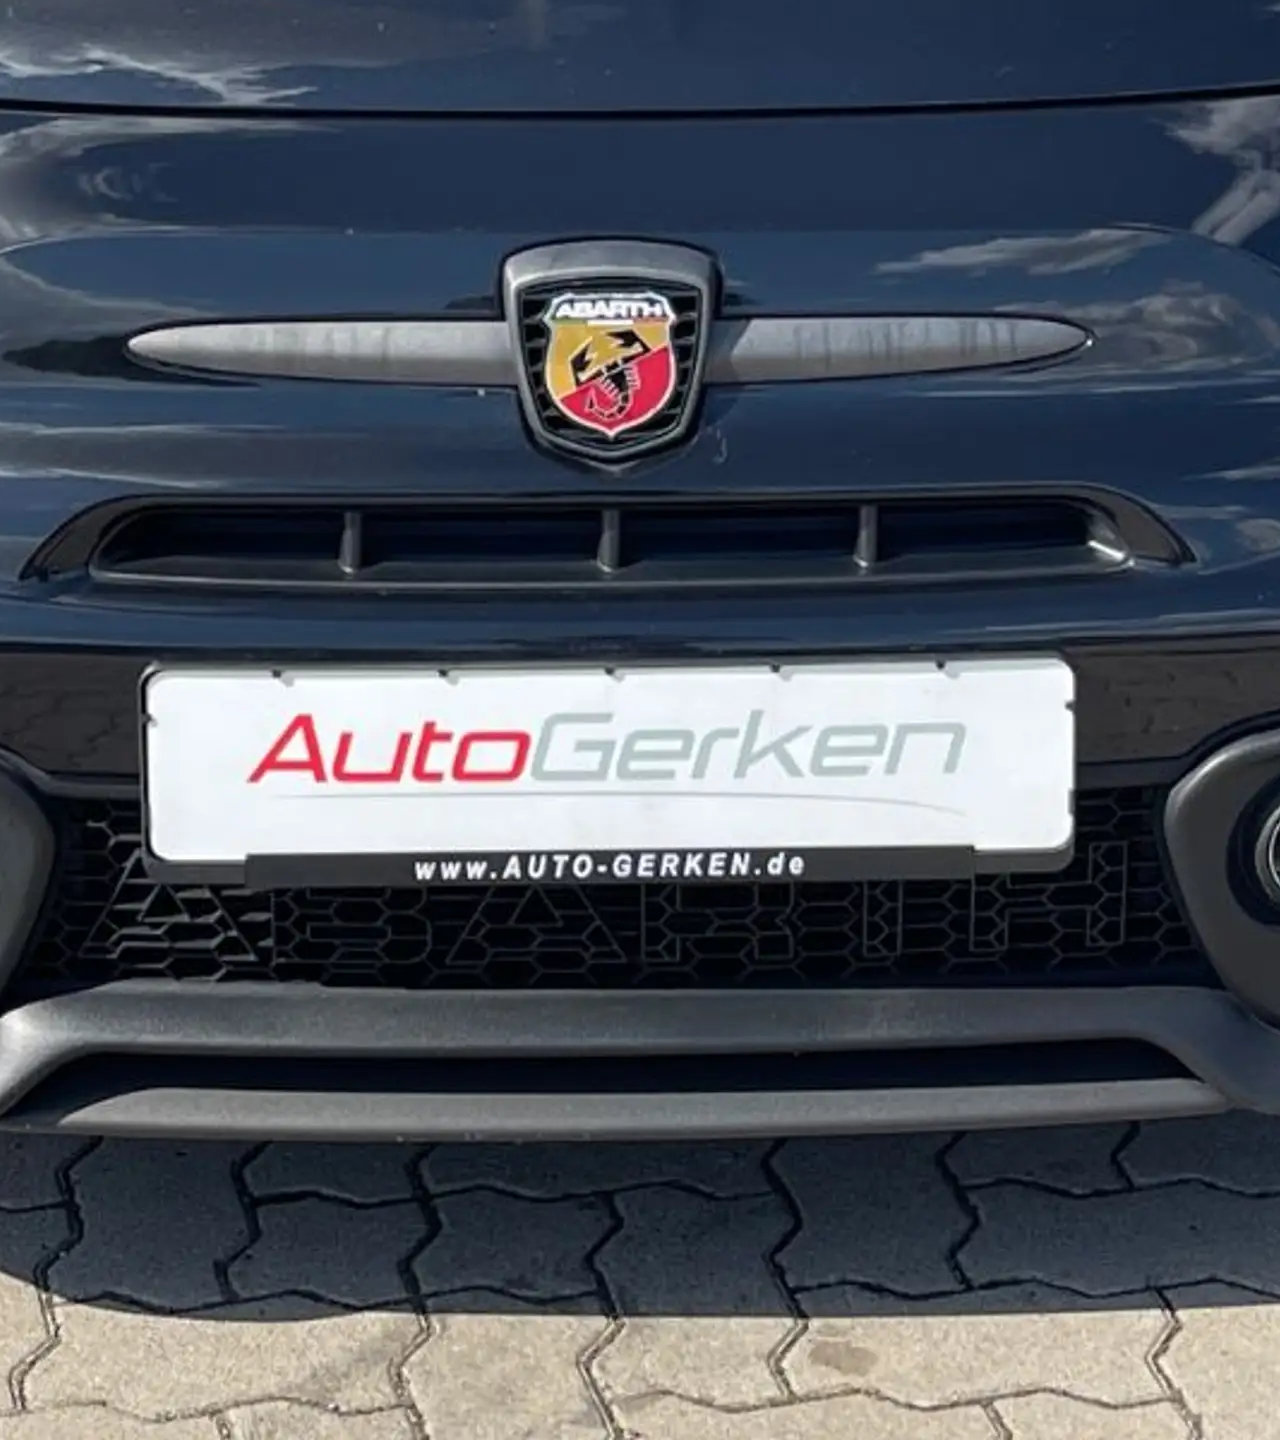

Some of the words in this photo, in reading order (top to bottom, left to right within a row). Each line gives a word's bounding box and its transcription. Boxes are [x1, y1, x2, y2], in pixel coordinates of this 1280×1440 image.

[556, 299, 663, 319] ABARTH
[247, 709, 967, 784] AutoGerken
[414, 852, 806, 880] www.AUTO-GERKEN.de
